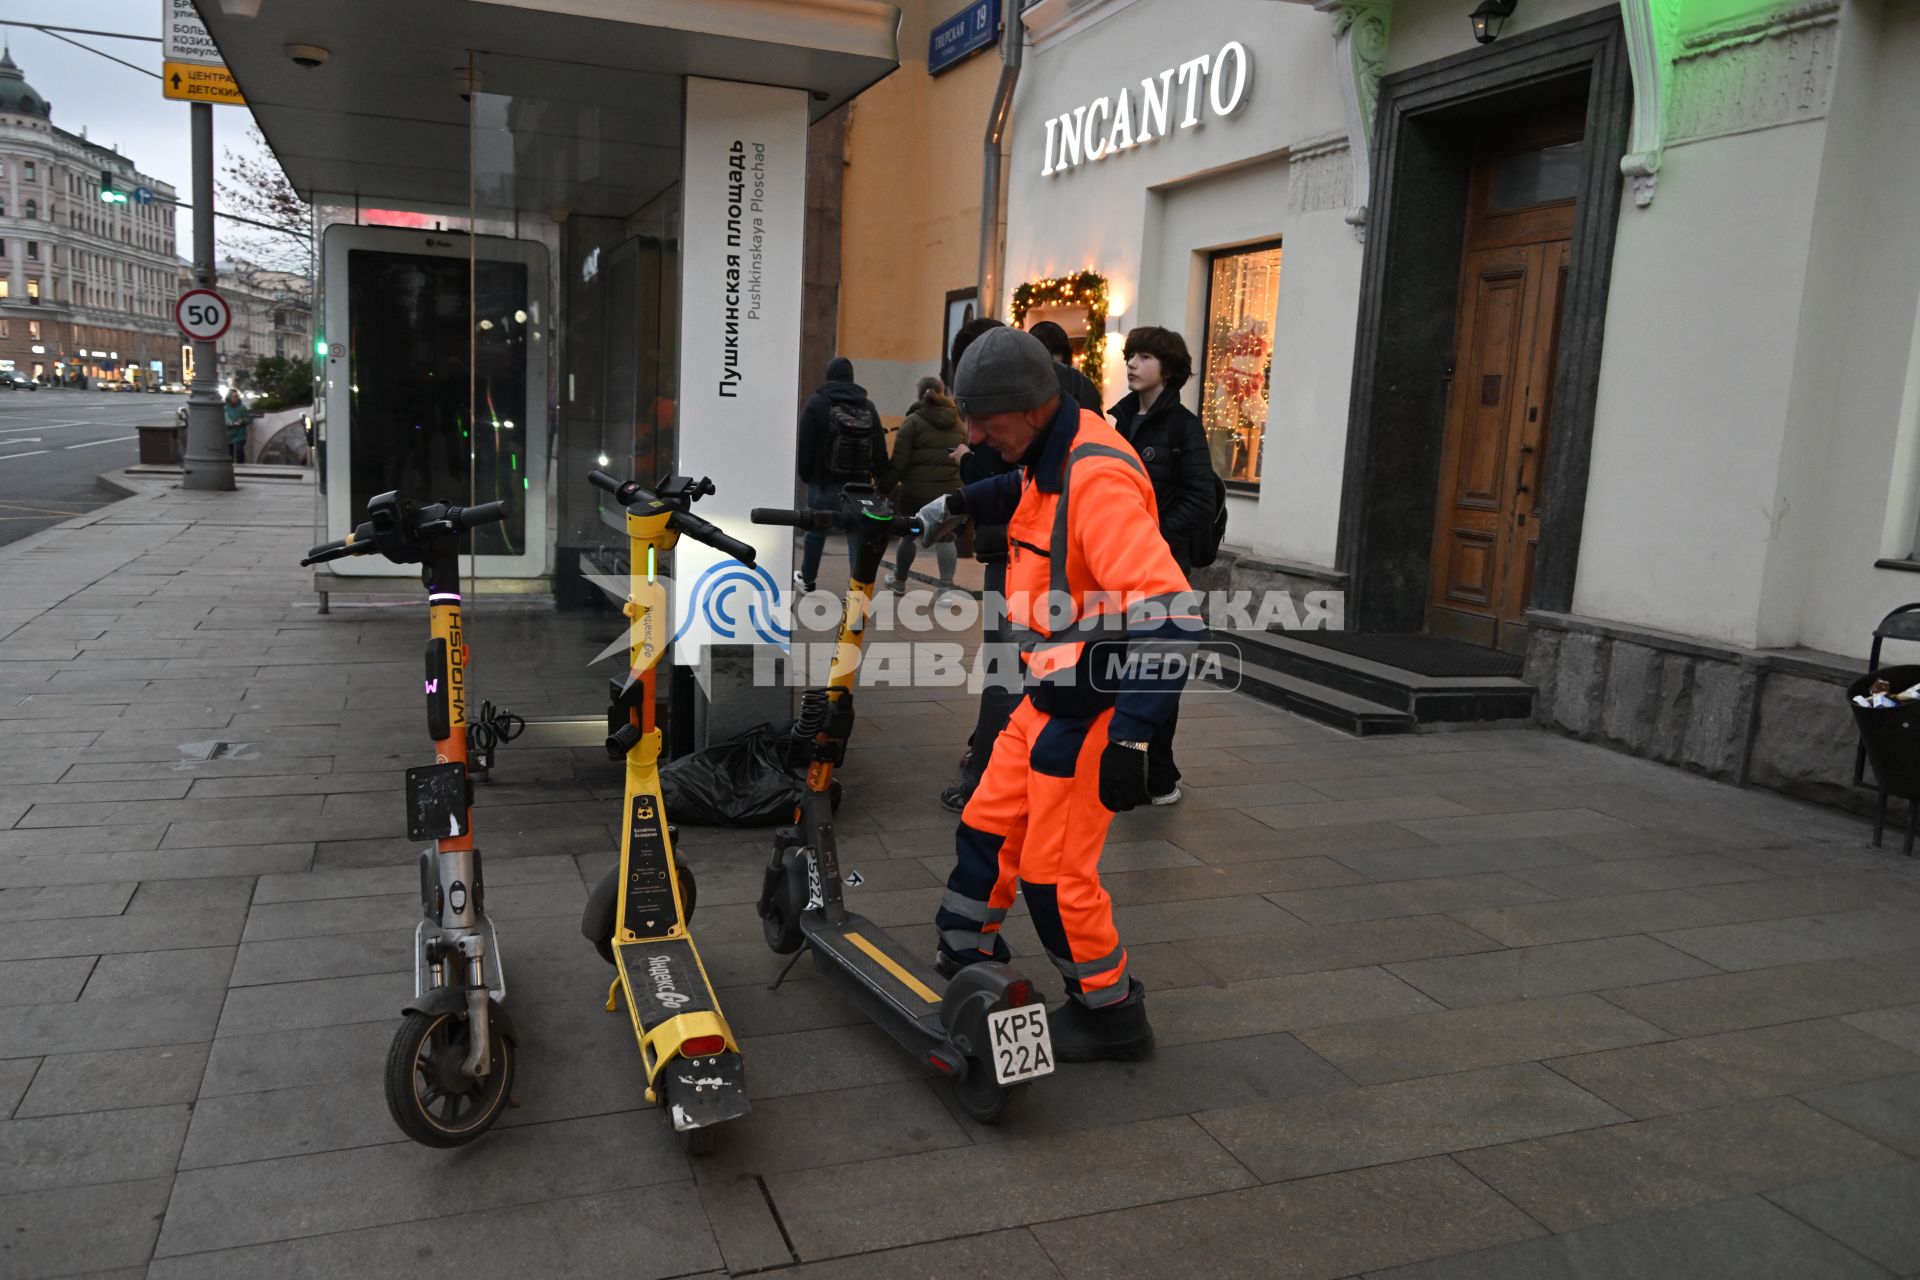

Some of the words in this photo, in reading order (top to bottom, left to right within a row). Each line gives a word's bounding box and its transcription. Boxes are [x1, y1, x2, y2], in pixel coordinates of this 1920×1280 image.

[173, 24, 208, 35] БОЛЬ
[976, 4, 987, 31] 19
[173, 35, 216, 47] КОЗИХ
[173, 45, 220, 57] переуло
[188, 71, 235, 83] ЦЕНТРА
[1041, 41, 1247, 177] INCANTO
[727, 139, 746, 247] площадь
[750, 142, 766, 212] Ploschad
[748, 217, 766, 321] Pushkinskaya
[188, 305, 219, 325] 50
[719, 253, 742, 398] Пушкинская
[449, 612, 465, 724] WHOOSH
[647, 955, 676, 992] Яндекс
[994, 1010, 1044, 1047] KP5
[1000, 1042, 1051, 1078] 22A
